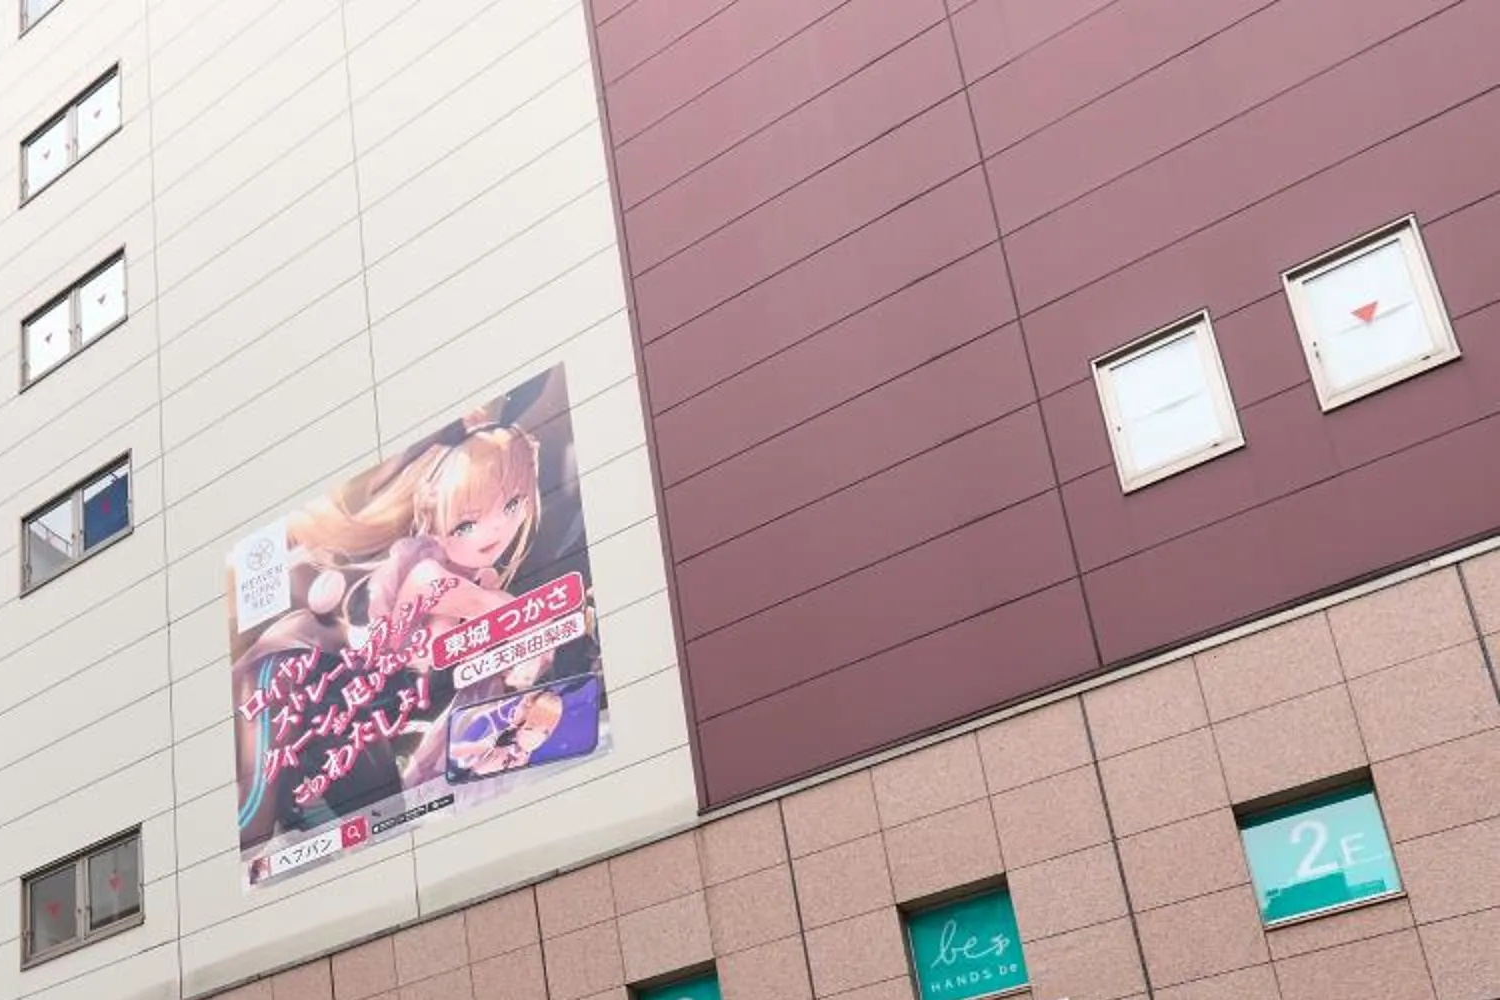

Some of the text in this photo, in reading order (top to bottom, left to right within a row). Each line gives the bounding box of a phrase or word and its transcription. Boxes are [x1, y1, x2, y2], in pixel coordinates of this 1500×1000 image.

[444, 584, 568, 659] 東城 つかさ
[238, 642, 323, 721] ロイヤル
[292, 672, 430, 805] このわたしよ!
[1288, 819, 1366, 879] 2F
[931, 969, 992, 992] HANDS
